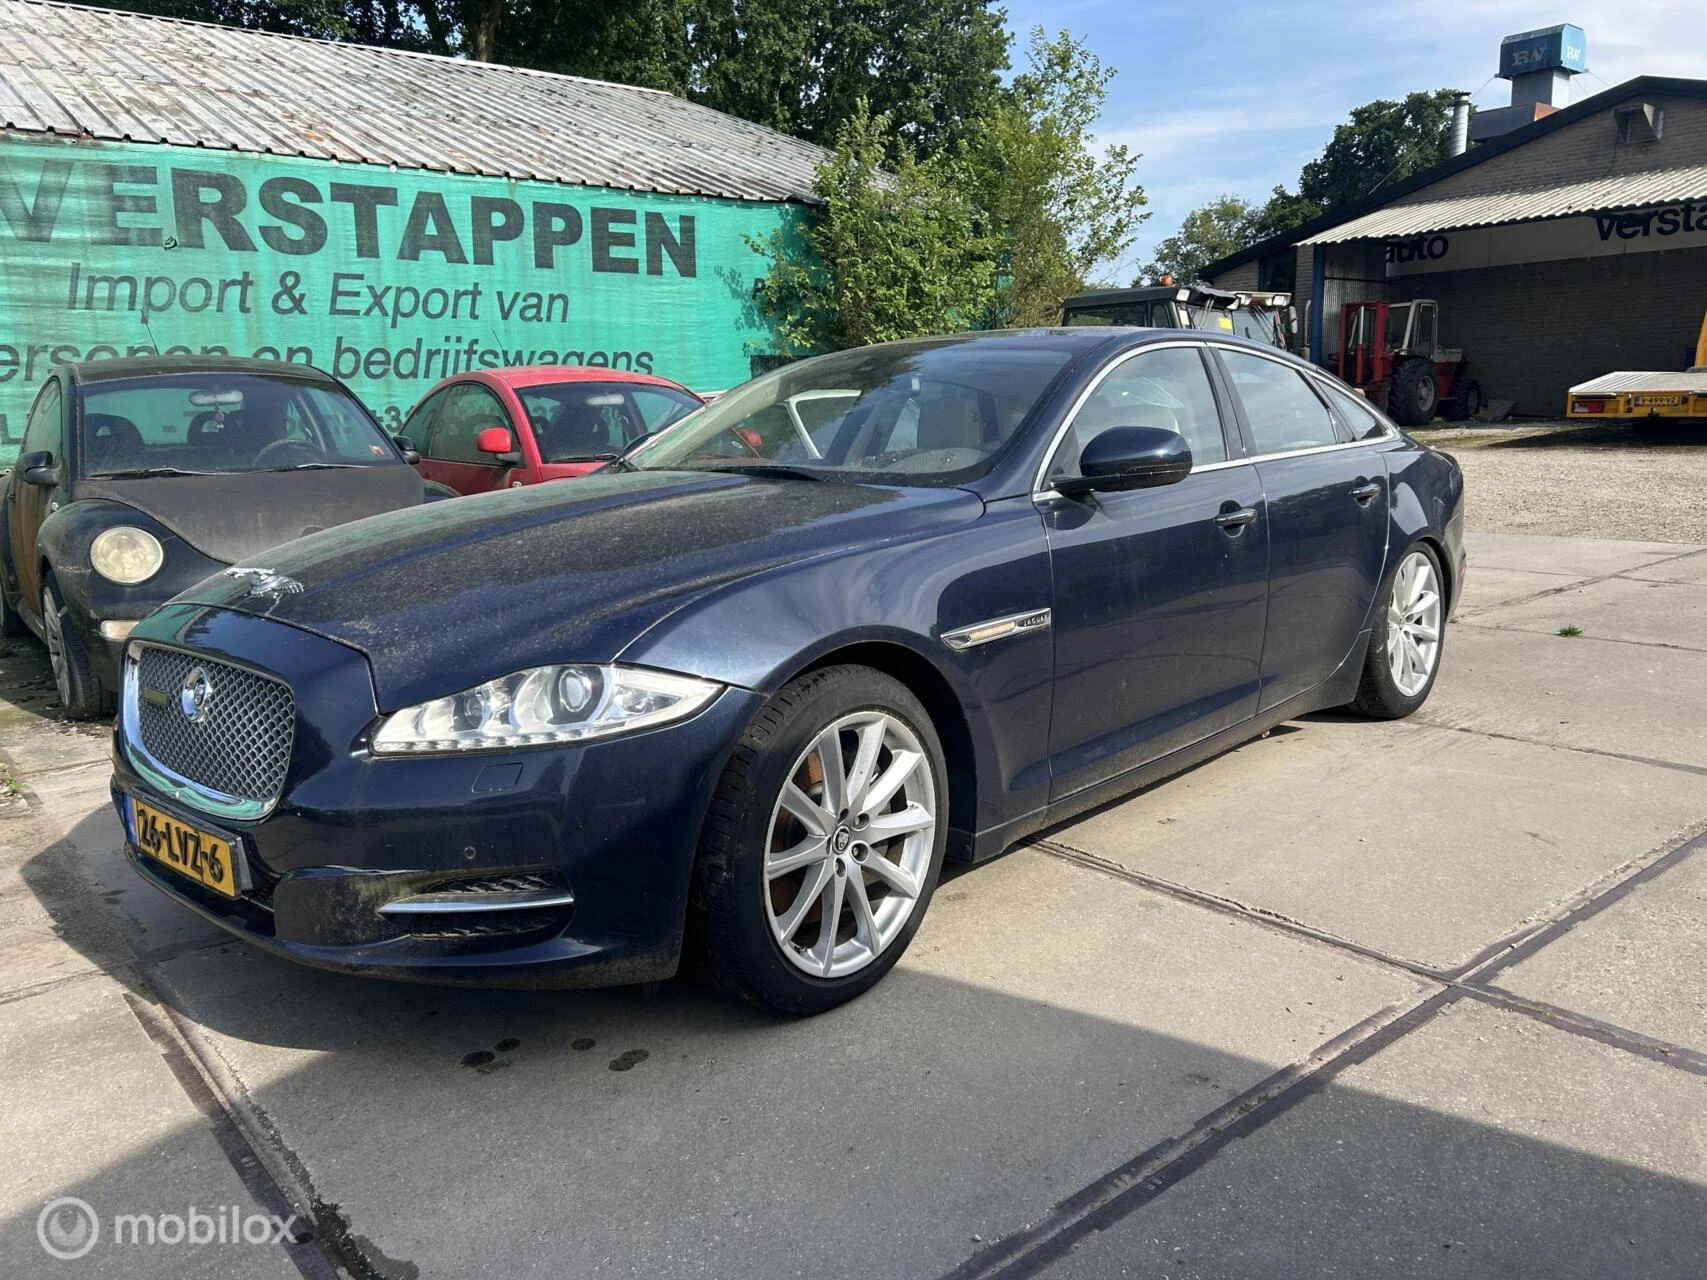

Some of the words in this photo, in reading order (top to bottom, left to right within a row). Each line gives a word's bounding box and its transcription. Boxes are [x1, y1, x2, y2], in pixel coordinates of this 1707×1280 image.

[0, 158, 698, 278] VERSTAPPEN
[67, 262, 254, 325] Import
[271, 270, 309, 316] &
[329, 271, 482, 329] Export
[496, 290, 570, 323] van
[1023, 613, 1049, 627] JAGUAR
[137, 808, 224, 884] 26-LVZ-6
